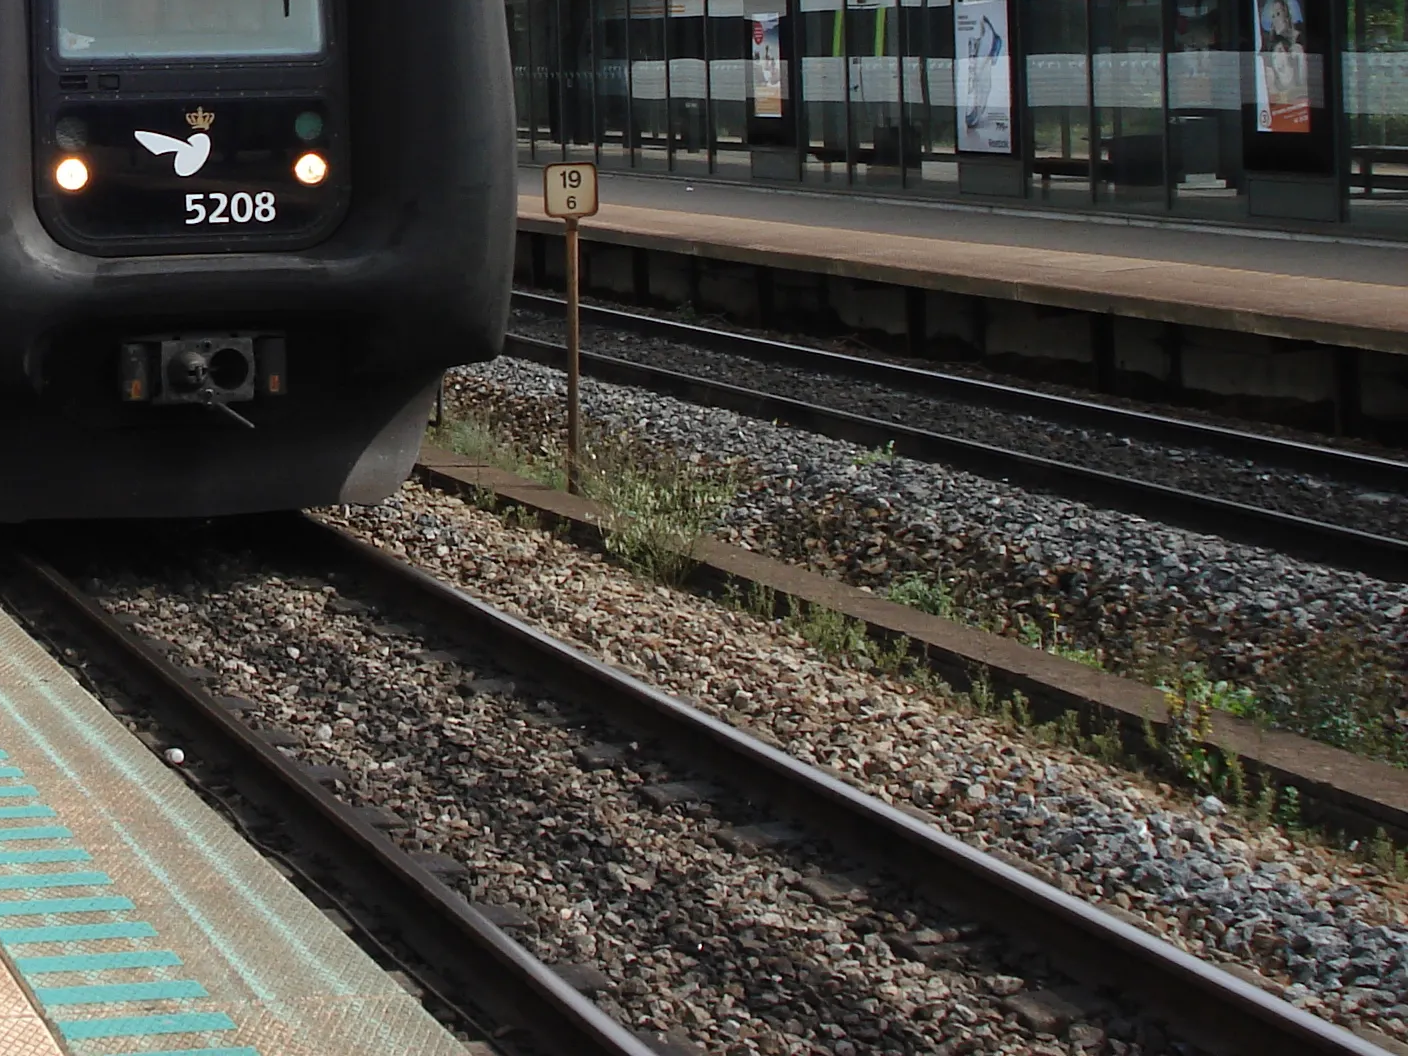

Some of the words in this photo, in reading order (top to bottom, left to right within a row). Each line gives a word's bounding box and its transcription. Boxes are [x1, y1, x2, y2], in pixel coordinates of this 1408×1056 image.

[560, 170, 581, 188] 19
[185, 191, 276, 225] 5208
[567, 196, 576, 209] 6
